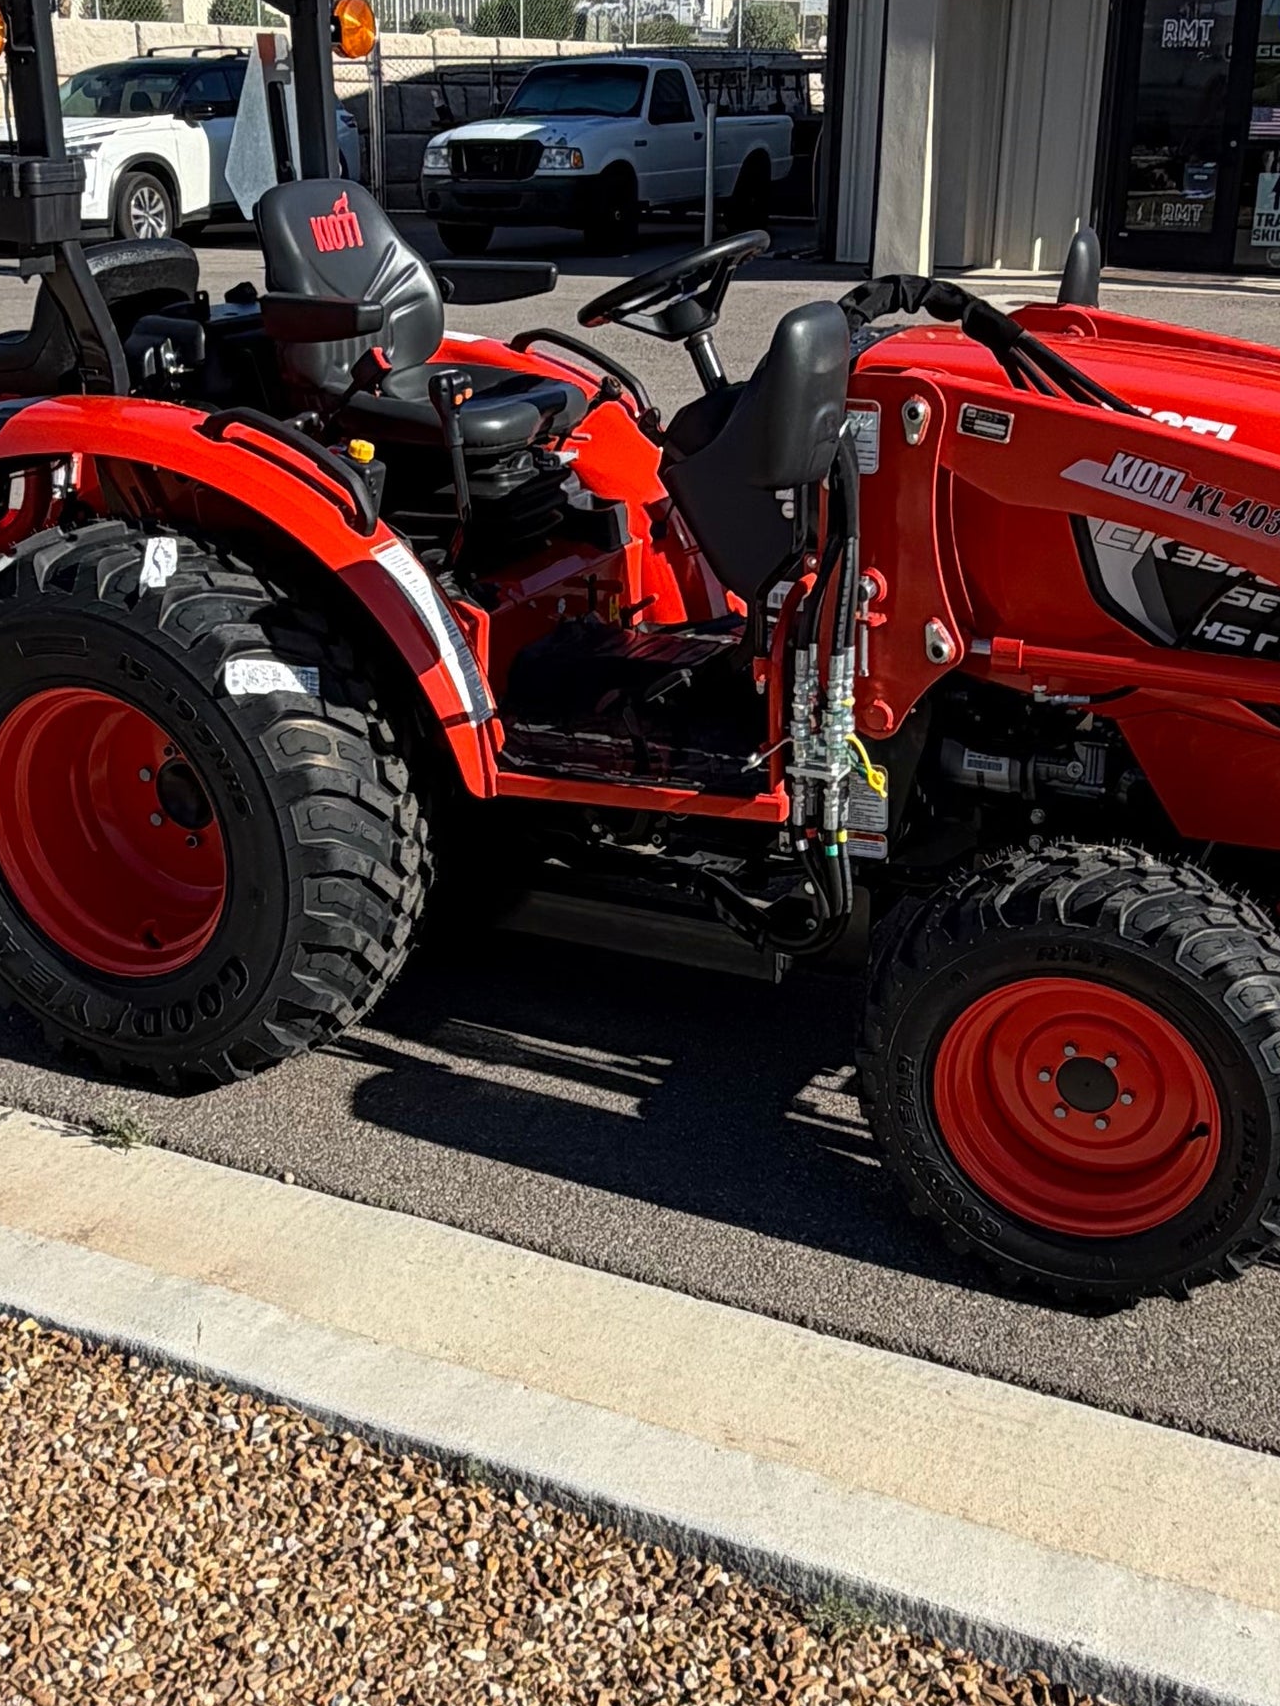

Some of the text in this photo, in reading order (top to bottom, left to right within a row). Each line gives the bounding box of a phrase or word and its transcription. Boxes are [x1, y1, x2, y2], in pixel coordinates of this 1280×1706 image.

[1161, 18, 1214, 41] RMT
[1161, 202, 1204, 222] RMT
[310, 212, 364, 252] KIOTI
[1104, 451, 1188, 503] KIOTI
[1188, 483, 1226, 518] KL
